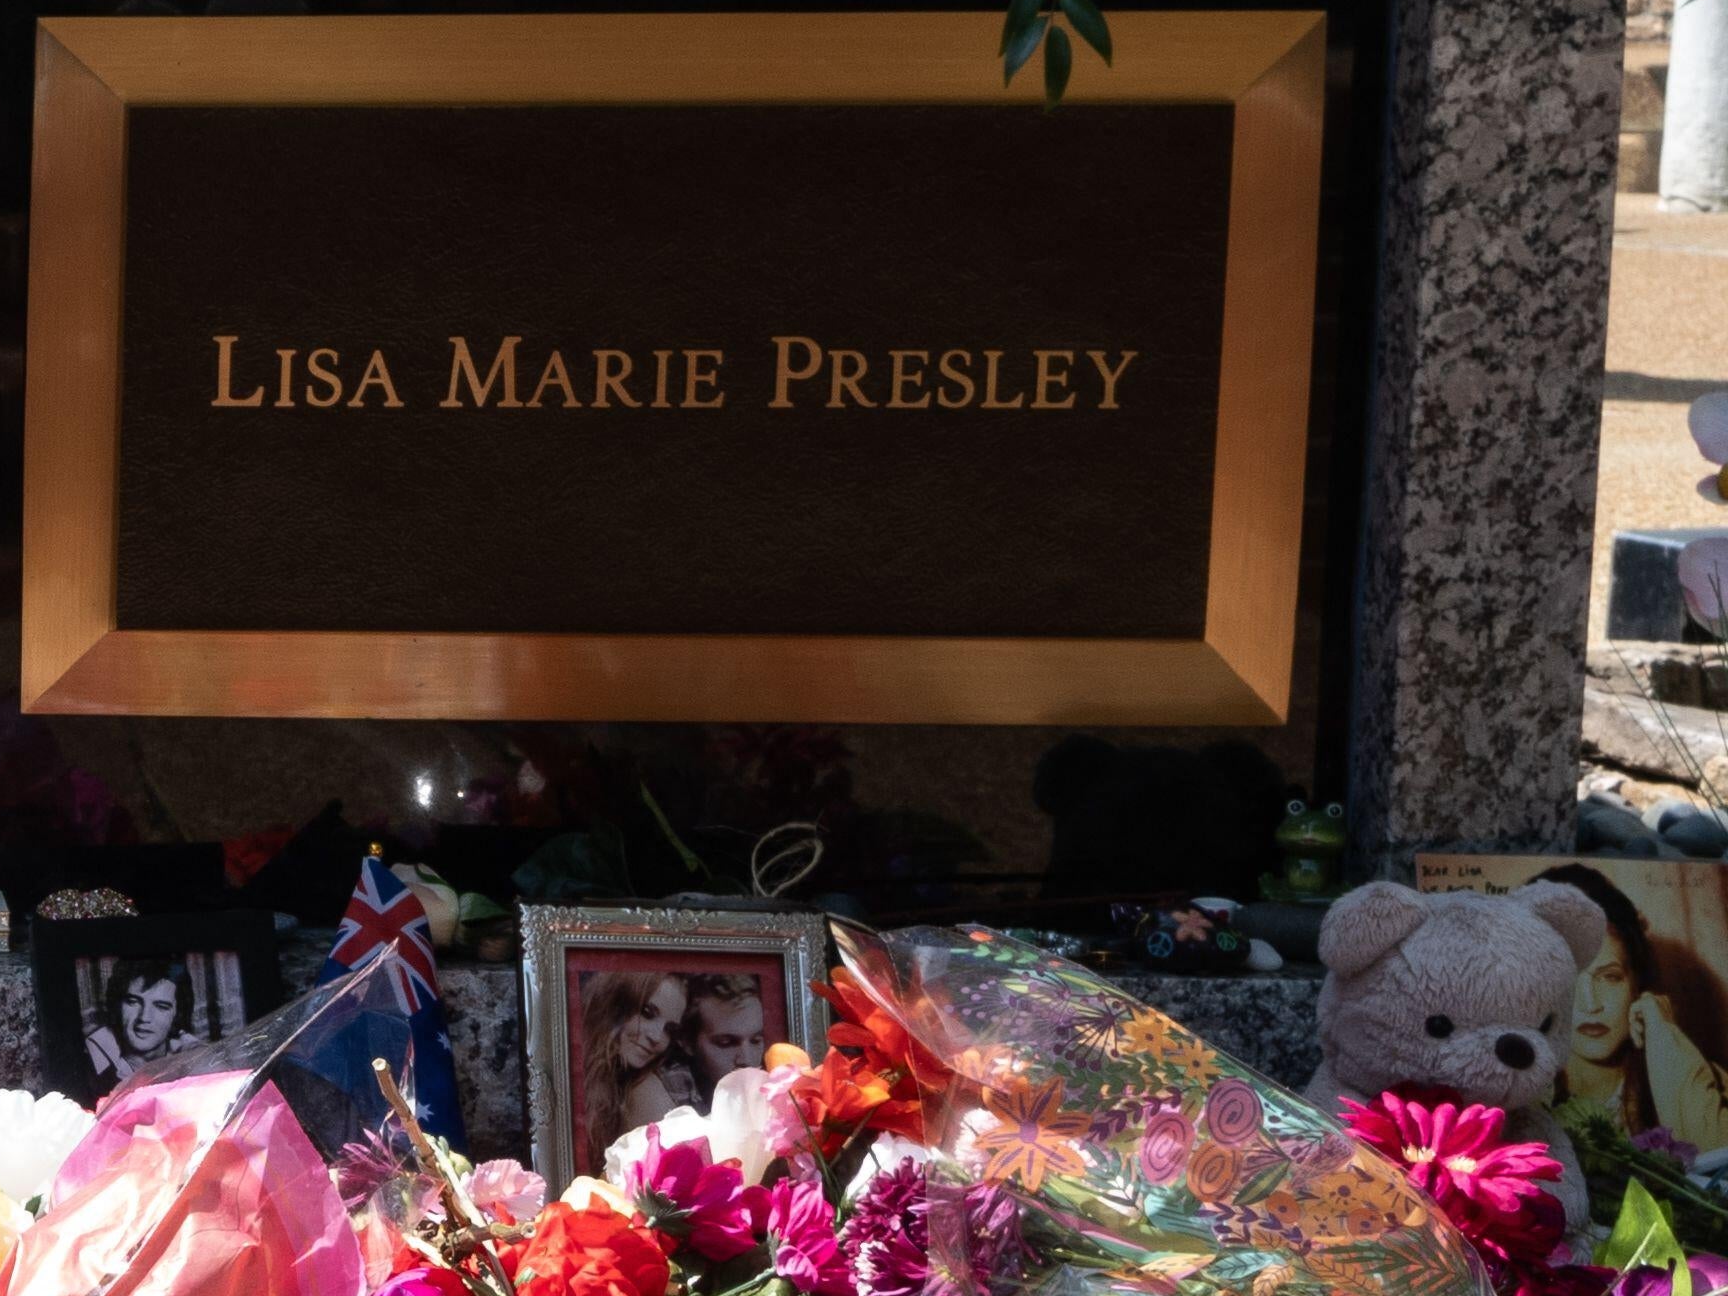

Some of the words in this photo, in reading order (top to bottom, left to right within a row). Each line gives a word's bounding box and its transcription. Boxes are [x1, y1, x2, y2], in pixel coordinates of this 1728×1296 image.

[210, 334, 405, 409] LISA
[438, 335, 724, 409] MARIE
[768, 335, 1138, 410] PRESLEY
